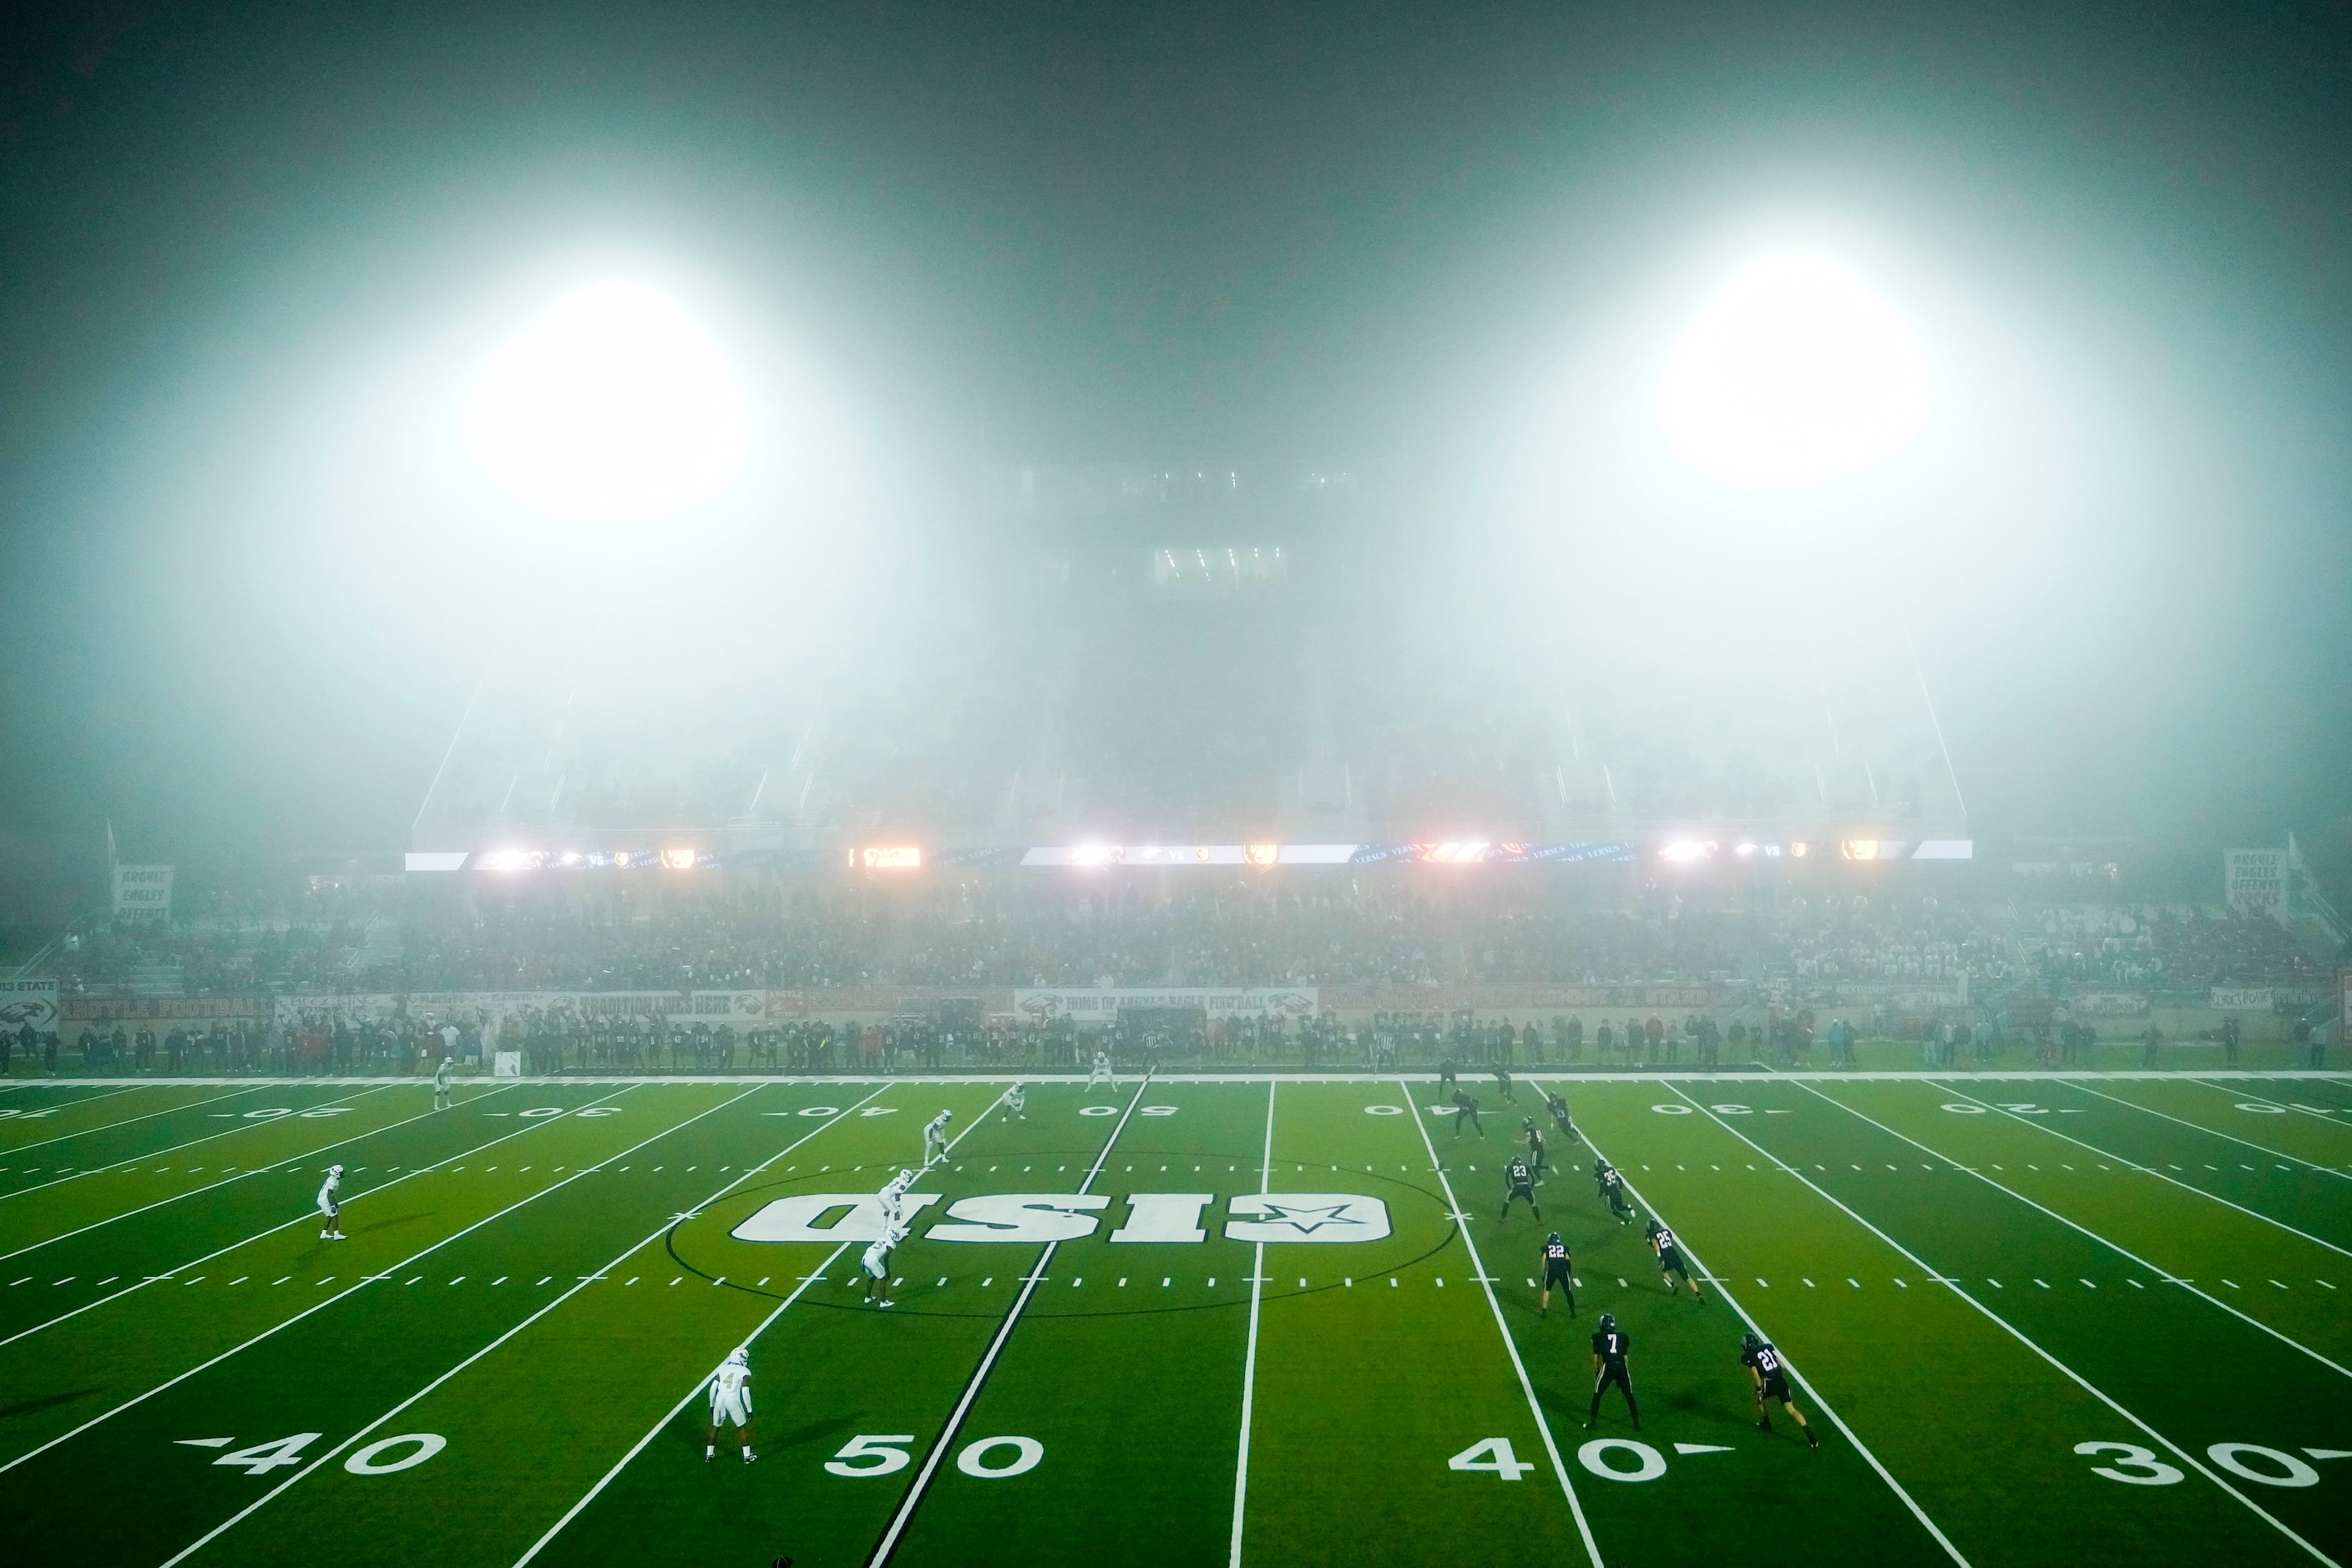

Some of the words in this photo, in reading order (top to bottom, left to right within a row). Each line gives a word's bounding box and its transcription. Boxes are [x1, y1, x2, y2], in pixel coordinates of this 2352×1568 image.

[1170, 850, 1184, 862] VS
[1533, 846, 1565, 859] VERSUS
[1588, 843, 1621, 857] VERSUS
[1765, 846, 1781, 857] VS
[1355, 853, 1388, 865] VERSUS
[2234, 866, 2278, 878] EAGLES
[2231, 879, 2280, 891] OFFENSE
[0, 982, 14, 991] 13
[18, 982, 55, 991] STATE
[580, 995, 652, 1014] TRADITION
[695, 994, 731, 1014] HERE
[1066, 996, 1100, 1010] HOME
[1101, 995, 1115, 1009] OF
[1210, 995, 1266, 1009] FOOTBALL
[1534, 989, 1608, 1004] COMMIT
[60, 999, 149, 1019] ARGYLE
[159, 996, 274, 1017] FOOTBALL
[1079, 1105, 1180, 1116] 50
[1512, 1165, 1527, 1177] 23
[1604, 1170, 1616, 1186] 35
[1657, 1231, 1672, 1249] 25
[1548, 1244, 1565, 1258] 22
[1607, 1333, 1618, 1353] 7
[1757, 1348, 1778, 1372] 21
[723, 1372, 734, 1389] 4
[210, 1433, 448, 1476] 40
[824, 1434, 1044, 1478] 50
[1448, 1437, 1667, 1483] 40
[2073, 1441, 2320, 1488] 30
